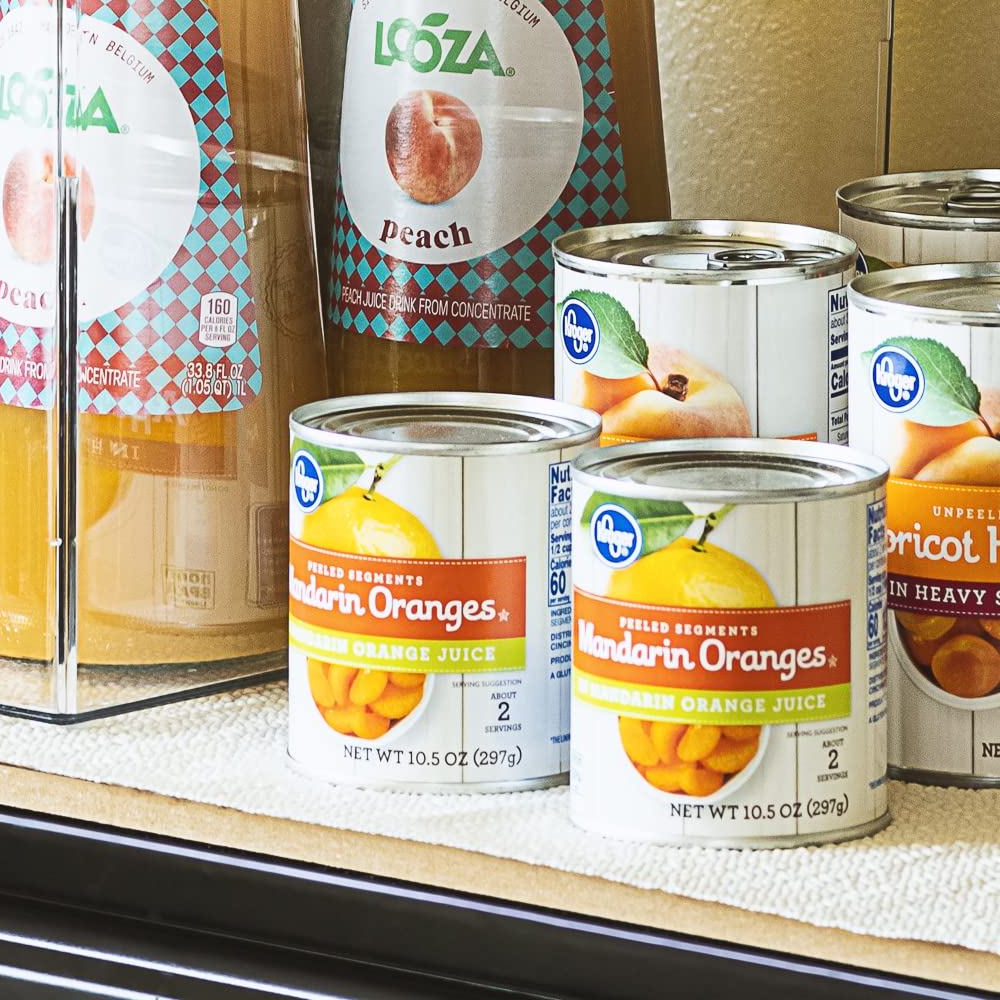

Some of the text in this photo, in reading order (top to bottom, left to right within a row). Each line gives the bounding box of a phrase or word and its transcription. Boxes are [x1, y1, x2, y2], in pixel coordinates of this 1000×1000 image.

[105, 40, 155, 84] BELGIUM
[378, 219, 473, 249] peach
[207, 298, 231, 315] 160
[342, 285, 532, 322] PEACH JUICE DRINK FROM CONCENTRATE
[201, 325, 213, 333] PER
[219, 325, 226, 333] FL
[227, 325, 236, 334] OZ
[204, 316, 234, 324] CALORIES
[204, 334, 232, 342] SERVING
[564, 309, 593, 353] Kroger
[0, 355, 23, 377] DRINK
[78, 365, 142, 388] NCENTRATE
[187, 361, 244, 380] 33.8 FL OZ
[875, 356, 916, 402] Kroger
[181, 378, 247, 399] (1.05 QT) 1L
[551, 505, 568, 518] about
[932, 505, 1000, 520] UNPEEL
[307, 560, 424, 587] PEELED SEGMENTS
[550, 570, 566, 596] 60
[290, 562, 497, 633] andarin Oranges
[889, 580, 908, 598] IN
[915, 584, 987, 606] HEAVY
[619, 615, 758, 637] PEELED SEGMENTS
[353, 640, 496, 663] ORANGE JUICE
[578, 618, 827, 682] Mandarin Oranges
[481, 679, 523, 688] SUGGESTION
[490, 691, 517, 701] ABOUT
[681, 694, 765, 713] ORANGE
[772, 693, 827, 712] JUICE
[497, 701, 510, 721] 2
[484, 723, 522, 734] SERVINGS
[822, 738, 845, 749] ABOUT
[343, 744, 523, 768] NET WT 10.5 OZ (297g)
[828, 749, 839, 770] 2
[816, 770, 849, 783] SERVINGS
[670, 792, 849, 820] NET WT 10.5 OZ (297g)
